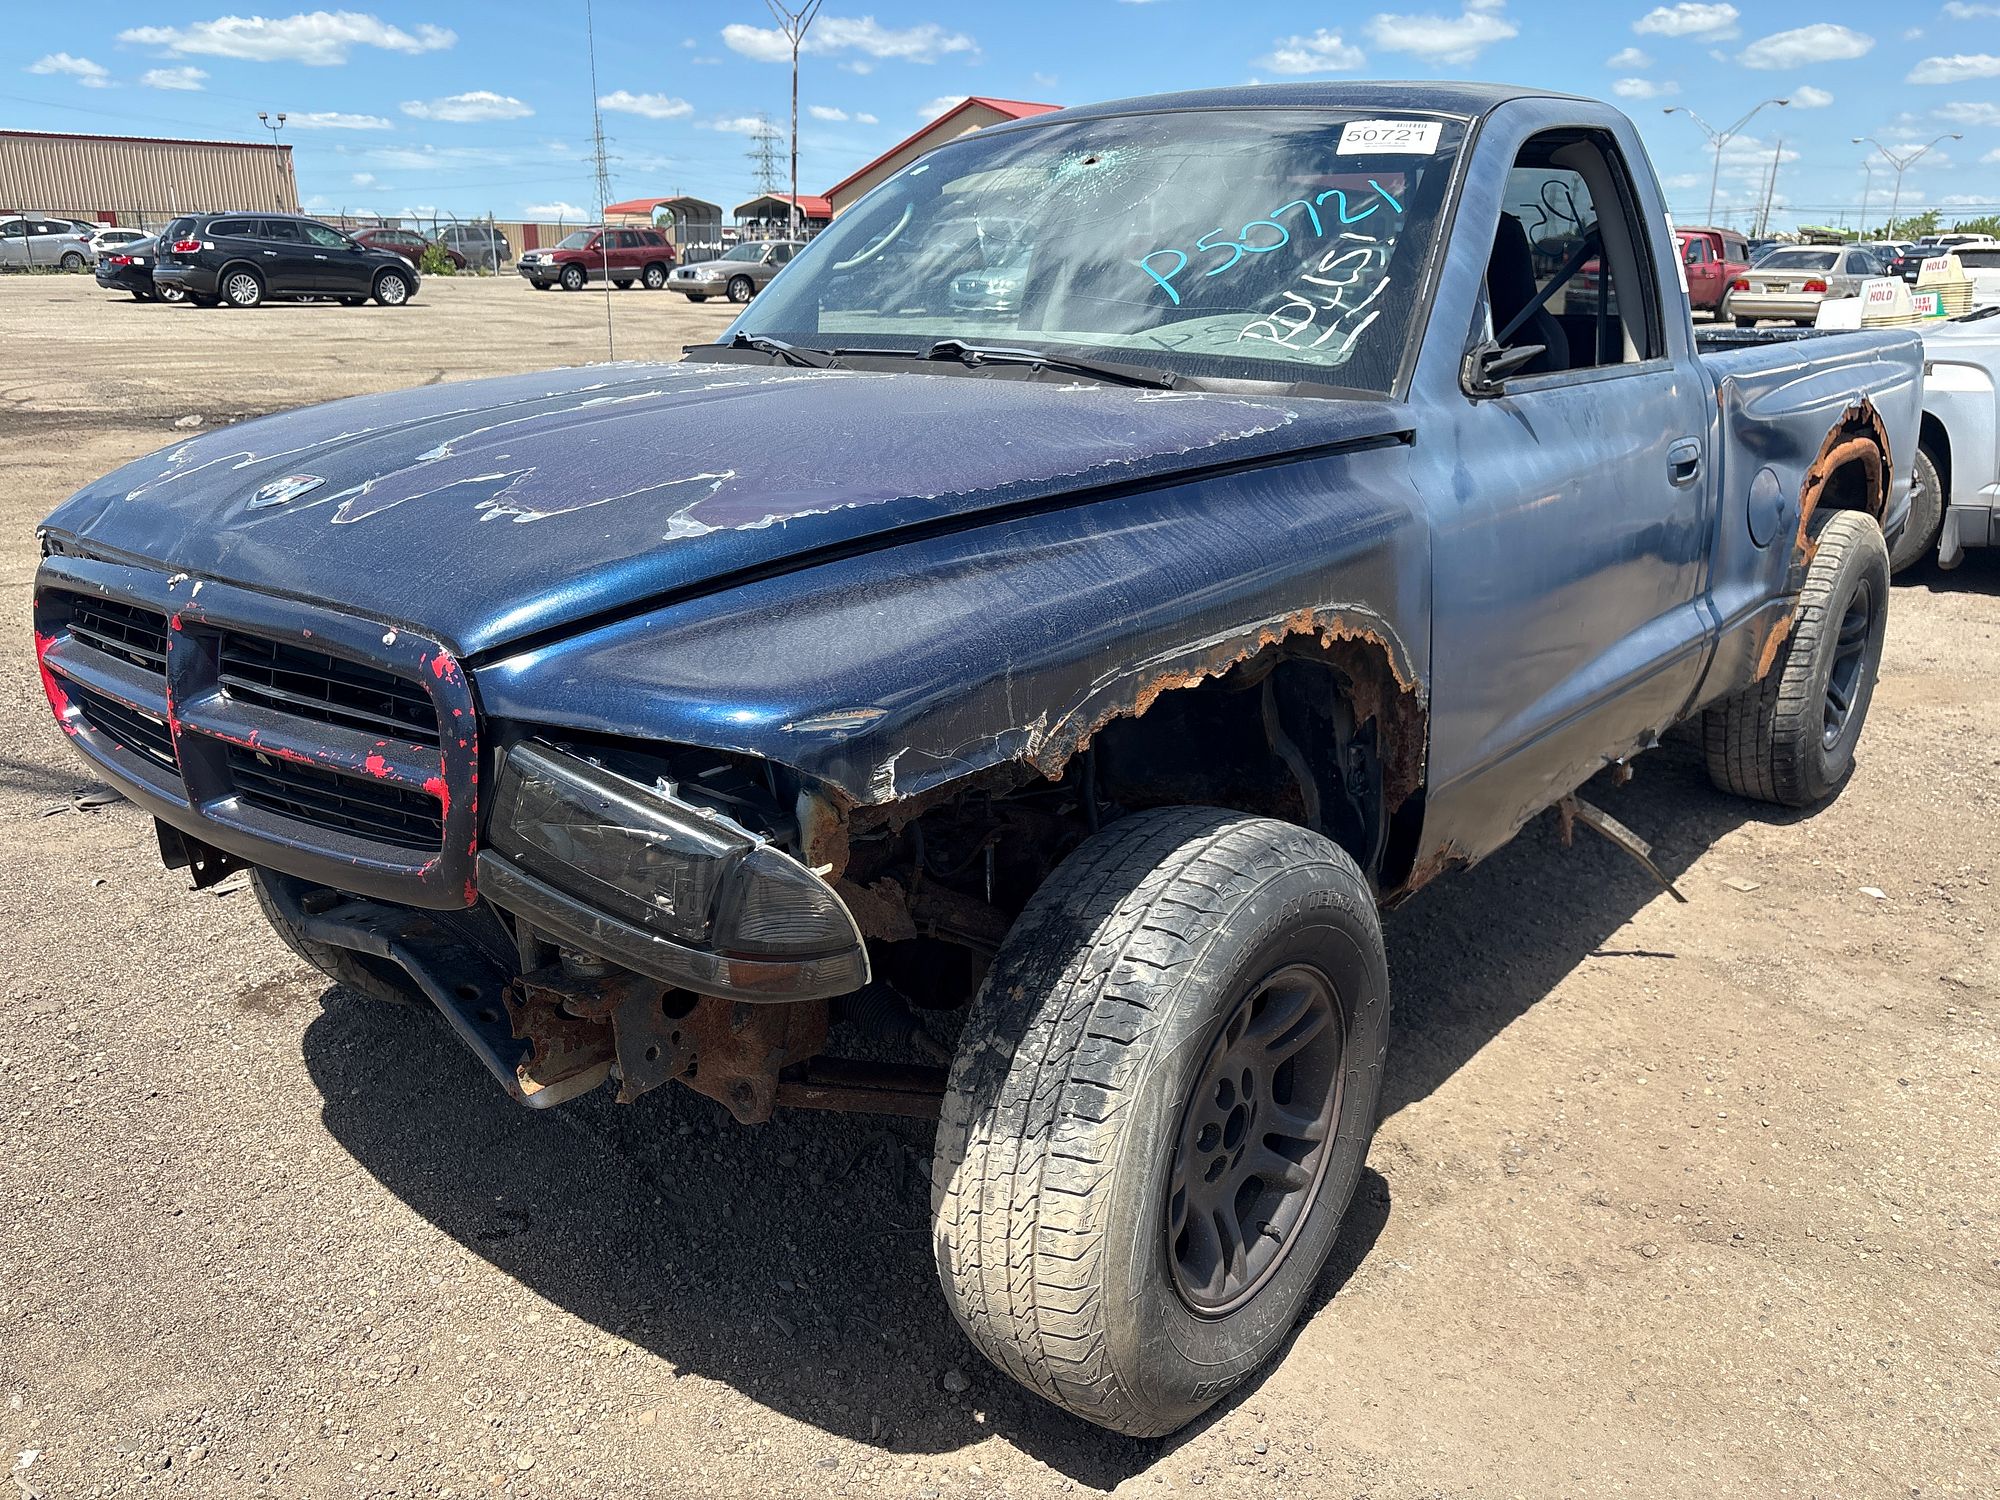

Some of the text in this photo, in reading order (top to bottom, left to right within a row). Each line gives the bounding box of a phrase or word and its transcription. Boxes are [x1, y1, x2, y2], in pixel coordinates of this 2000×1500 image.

[1346, 129, 1425, 142] 50721
[1140, 179, 1403, 306] P50721
[1925, 260, 1948, 272] HOLD
[1869, 290, 1893, 302] HOLD
[1915, 297, 1931, 305] TEST
